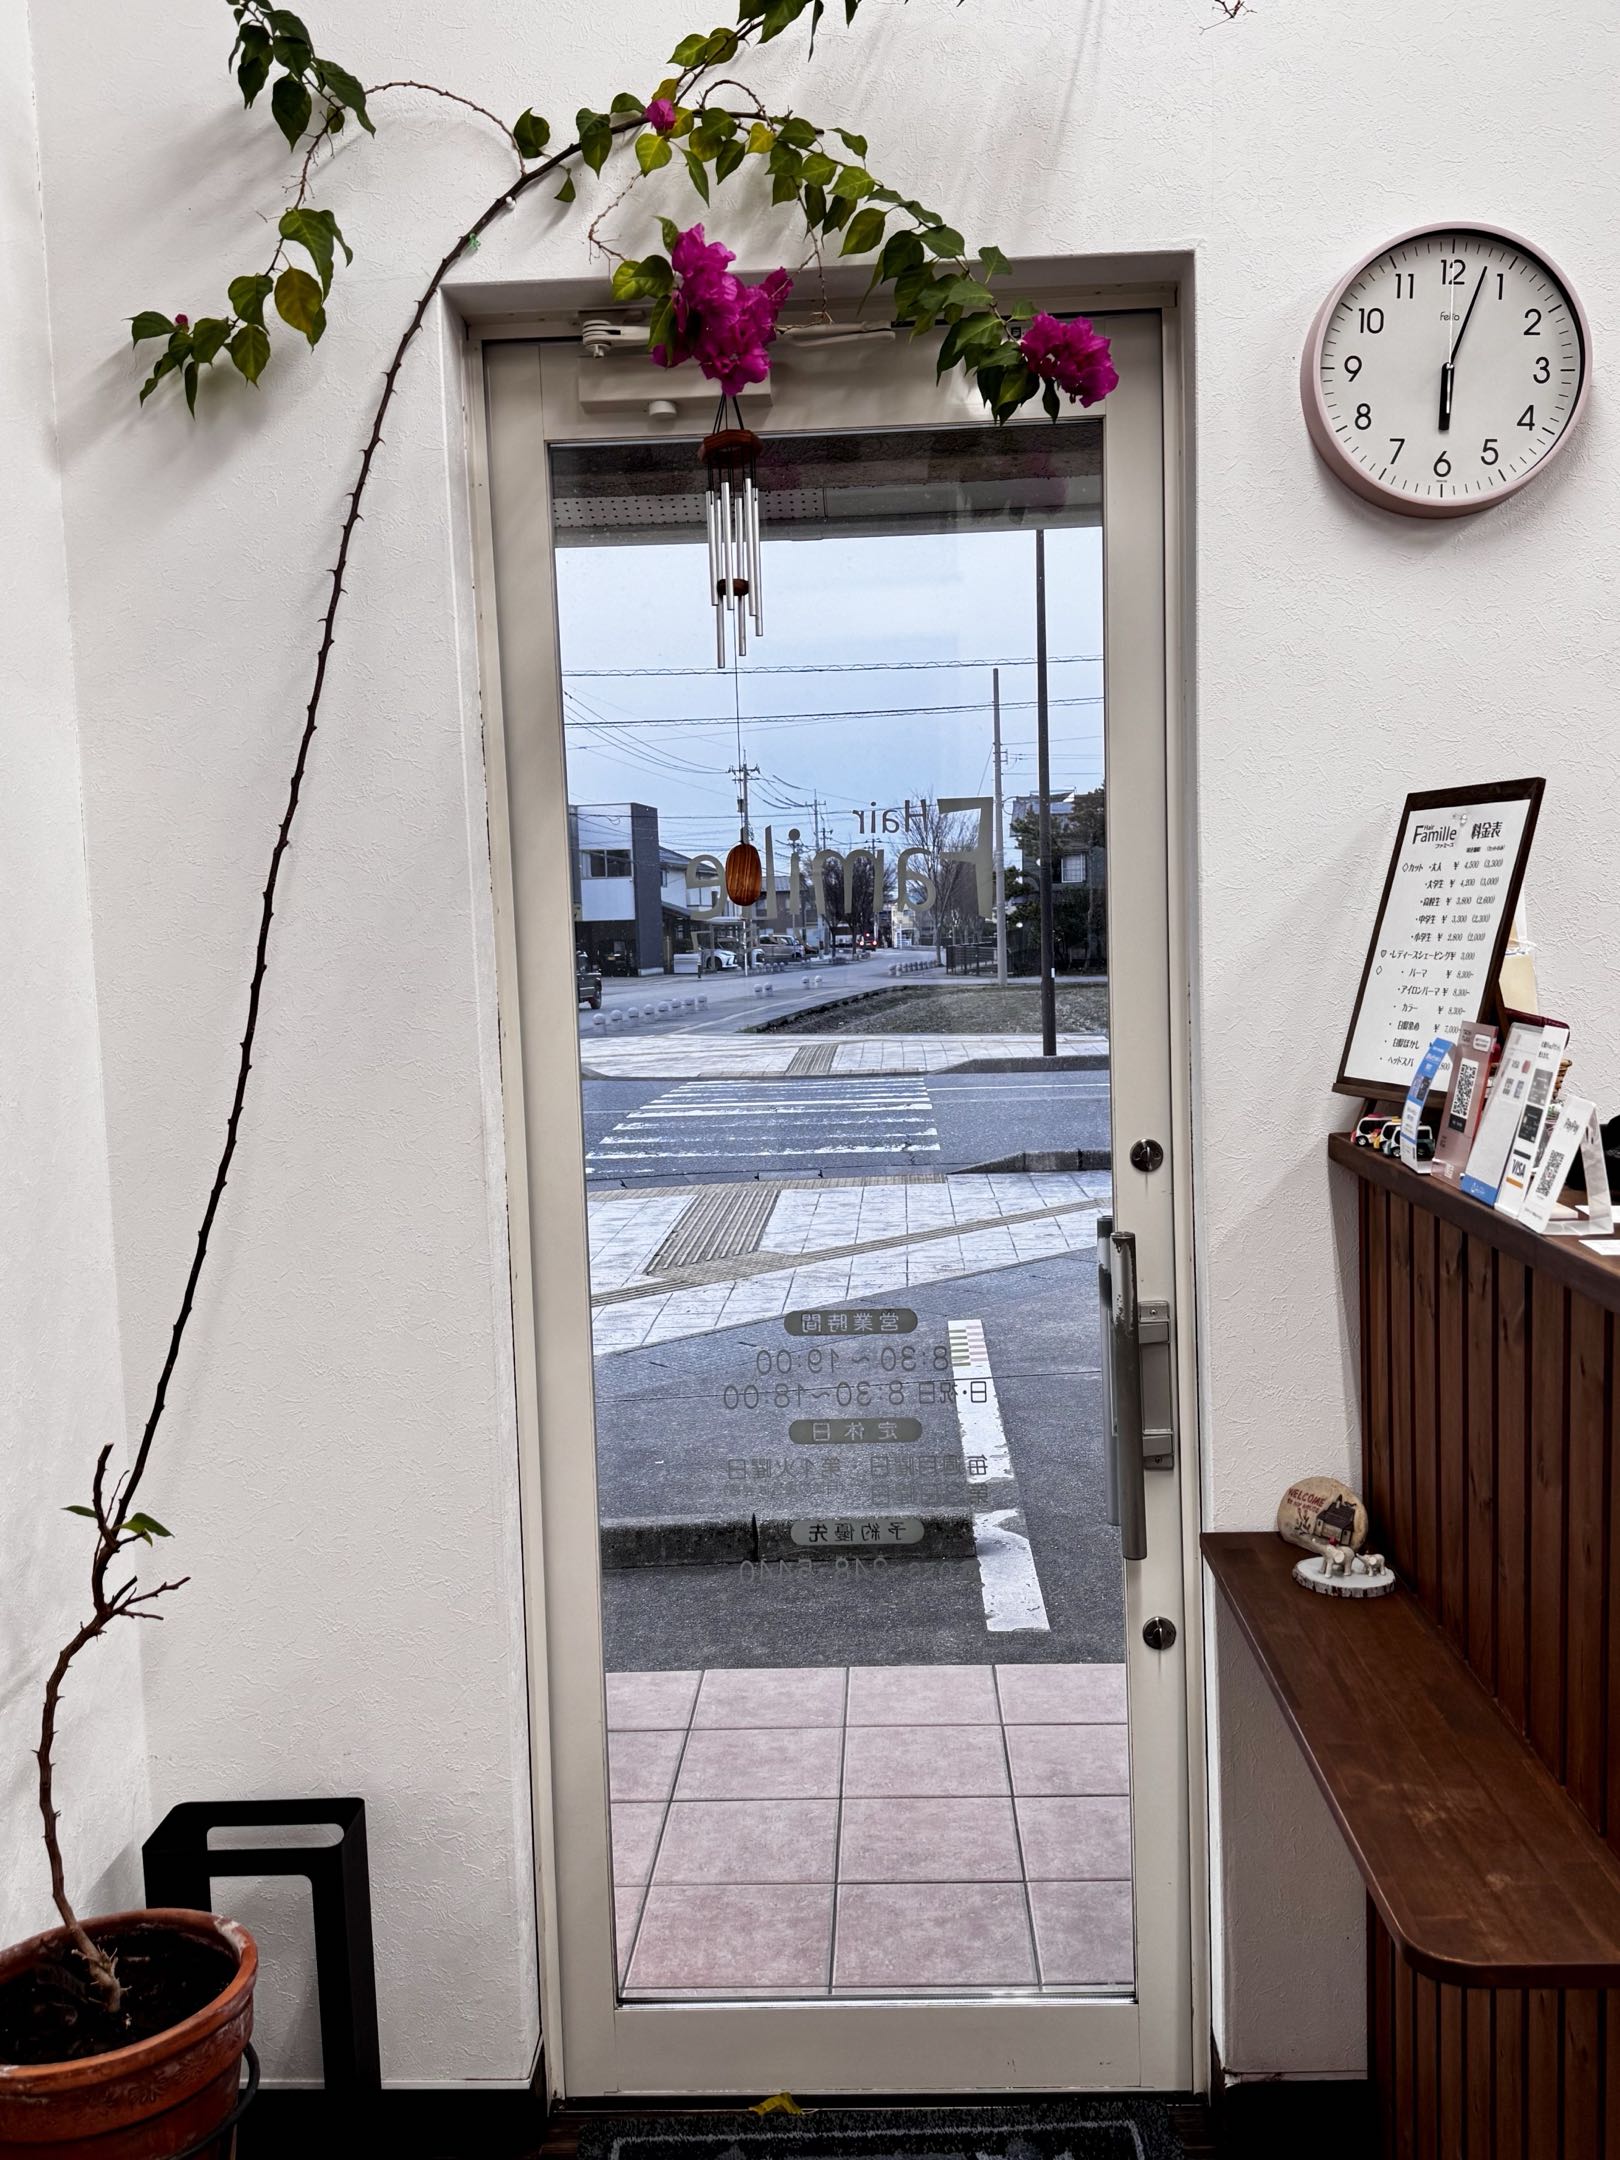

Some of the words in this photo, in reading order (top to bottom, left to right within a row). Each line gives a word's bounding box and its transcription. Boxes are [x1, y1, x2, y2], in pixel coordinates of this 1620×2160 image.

[1441, 259, 1465, 285] 12
[1395, 273, 1414, 299] 11
[1497, 273, 1504, 300] 1
[1359, 308, 1384, 333] 10
[1523, 309, 1542, 335] 2
[1344, 355, 1362, 382] 9
[1533, 357, 1550, 384] 3
[1354, 403, 1372, 430] 8
[1516, 405, 1535, 431] 4
[1389, 438, 1405, 465] 7
[1433, 450, 1451, 477] 6
[1480, 438, 1499, 465] 5
[1412, 825, 1457, 844] Famille
[1471, 822, 1503, 839] 料金表
[1512, 1159, 1526, 1179] VISA
[1288, 1488, 1327, 1507] WELCOME
